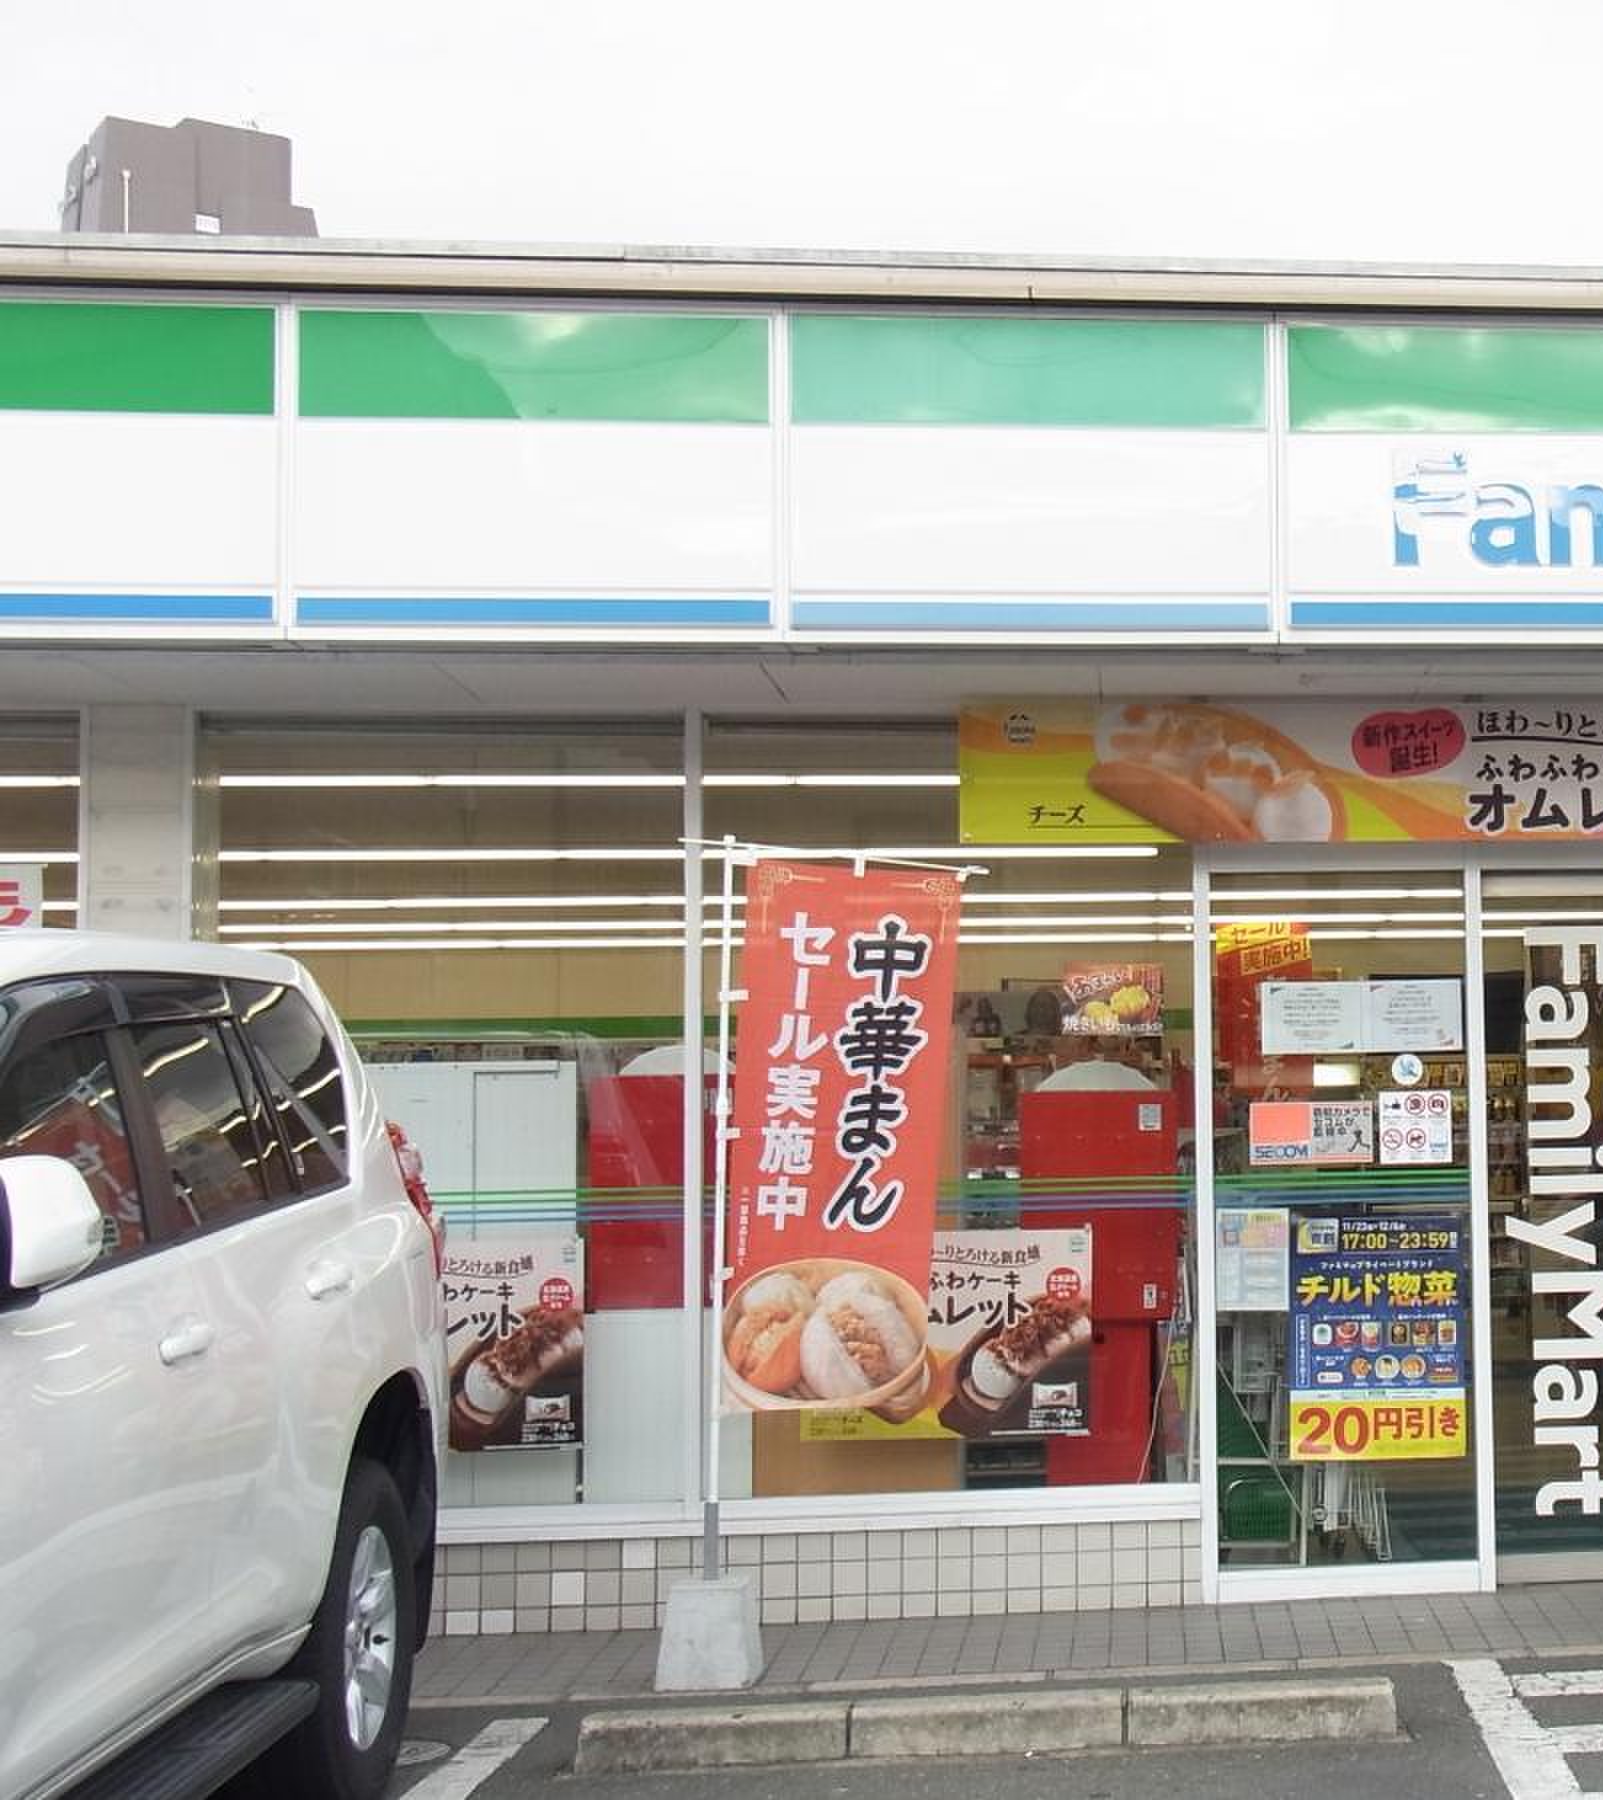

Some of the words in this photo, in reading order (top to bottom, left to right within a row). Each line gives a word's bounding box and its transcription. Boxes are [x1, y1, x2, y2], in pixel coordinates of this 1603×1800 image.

[1363, 719, 1456, 747] 新作スイーツ
[1029, 803, 1086, 824] チーズ
[756, 911, 835, 1231] セール実施中
[826, 916, 929, 1231] 中華まん
[1255, 1144, 1308, 1158] SECOM
[1296, 1270, 1459, 1307] チルド惣菜
[1297, 1405, 1460, 1455] 20円引き
